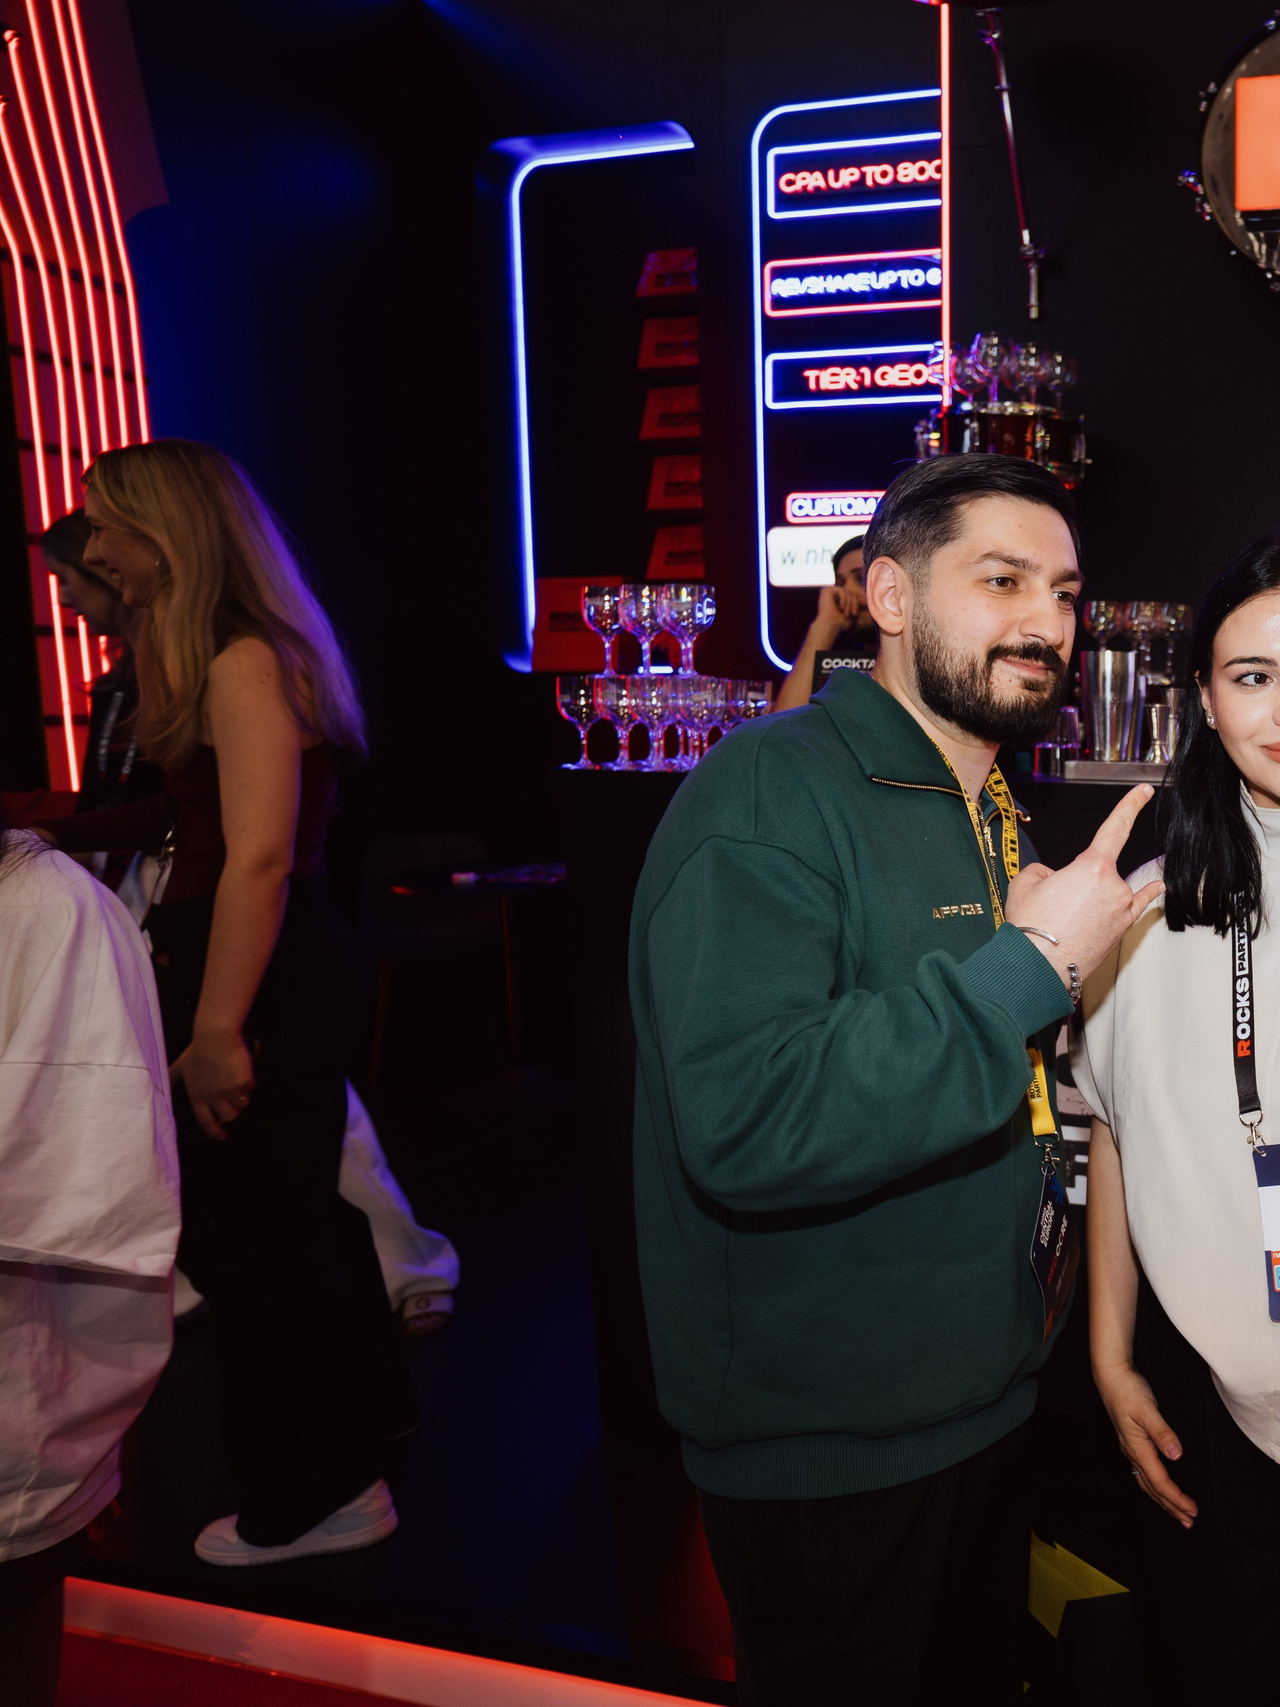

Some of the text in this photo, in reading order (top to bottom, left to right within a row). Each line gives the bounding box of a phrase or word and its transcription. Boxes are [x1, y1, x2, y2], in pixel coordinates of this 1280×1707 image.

[779, 172, 827, 193] CPA
[828, 168, 861, 189] UP
[860, 164, 895, 188] TO
[869, 270, 898, 289] UP
[897, 268, 926, 289] TO
[791, 497, 881, 517] CUSTOM
[1236, 976, 1251, 1058] ROCKS
